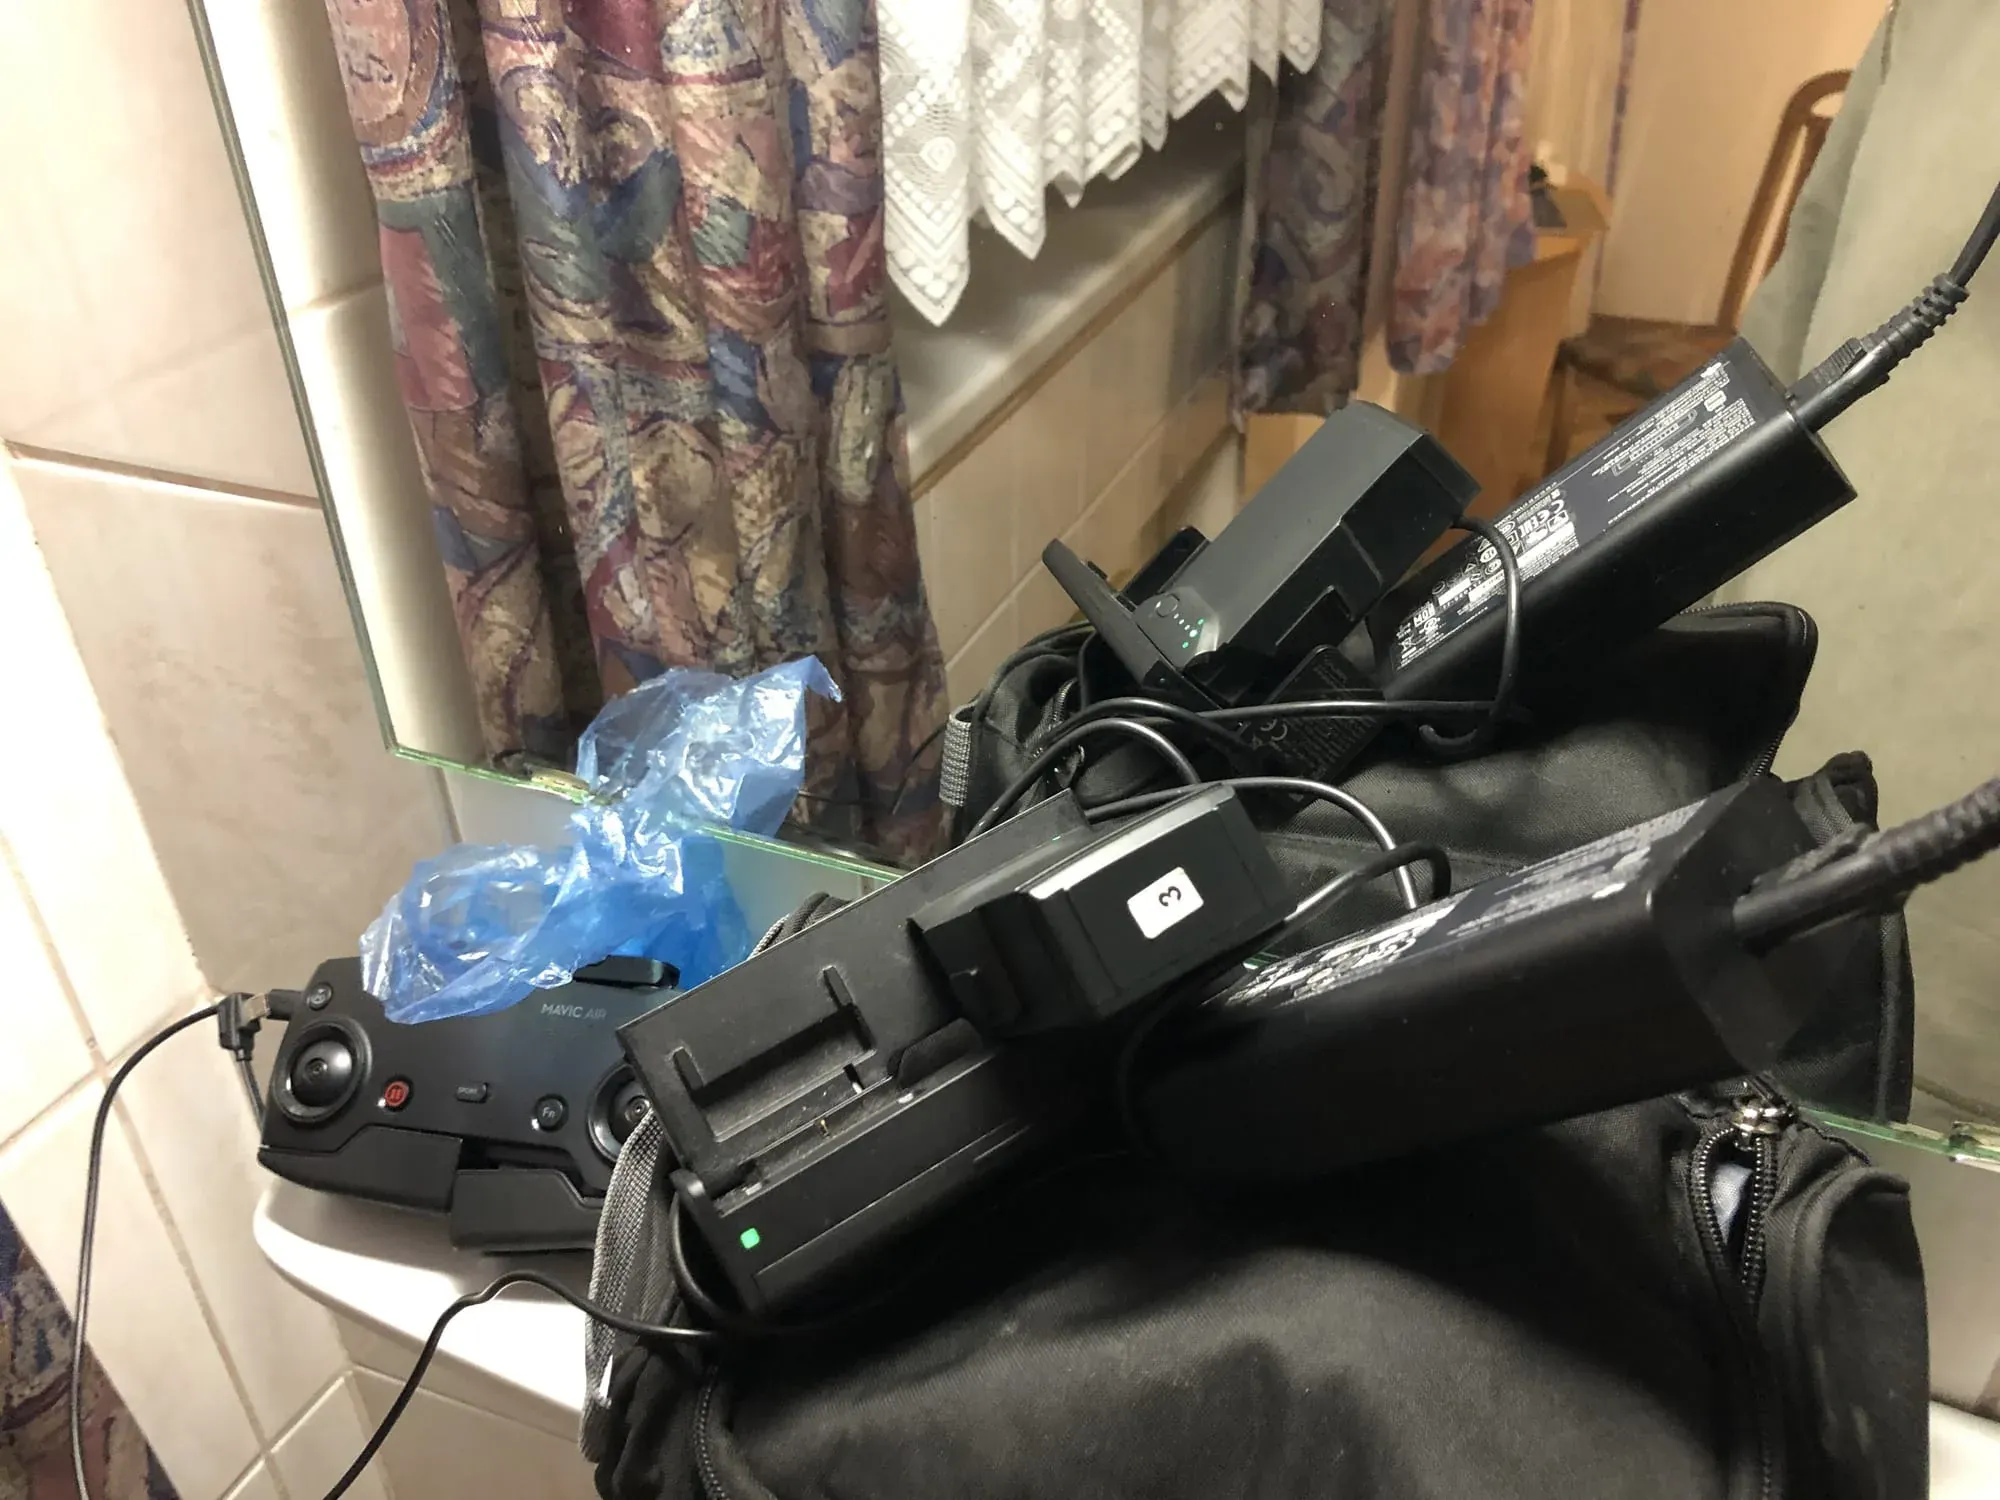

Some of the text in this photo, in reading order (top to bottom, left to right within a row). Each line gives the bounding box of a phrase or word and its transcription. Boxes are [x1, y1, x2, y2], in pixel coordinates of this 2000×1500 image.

[1158, 885, 1182, 907] 3
[540, 1002, 608, 1020] MAVIC AIR
[542, 1106, 556, 1118] Fn
